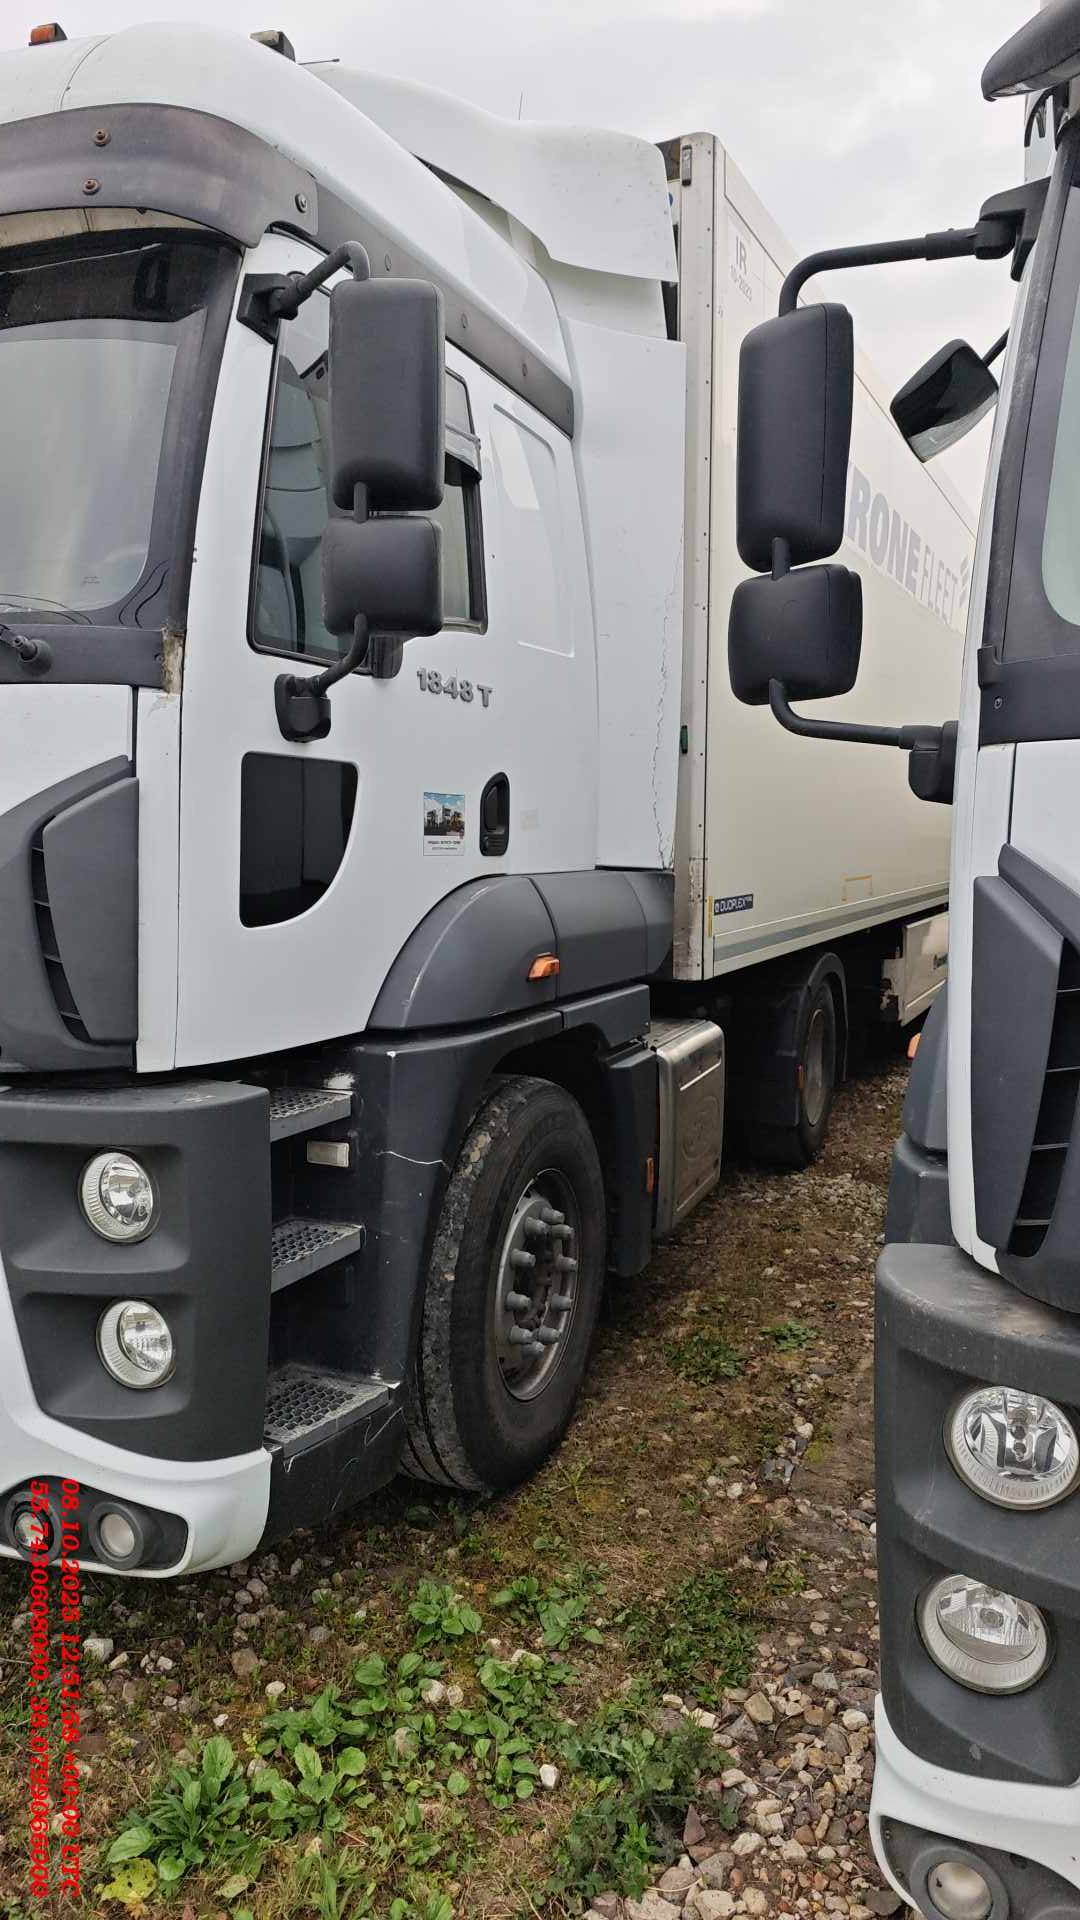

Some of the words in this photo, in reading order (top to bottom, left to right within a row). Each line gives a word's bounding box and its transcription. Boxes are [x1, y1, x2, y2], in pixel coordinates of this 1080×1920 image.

[847, 466, 921, 597] RONE
[921, 544, 959, 634] FLEET
[416, 667, 473, 702] 1848
[477, 684, 493, 707] T
